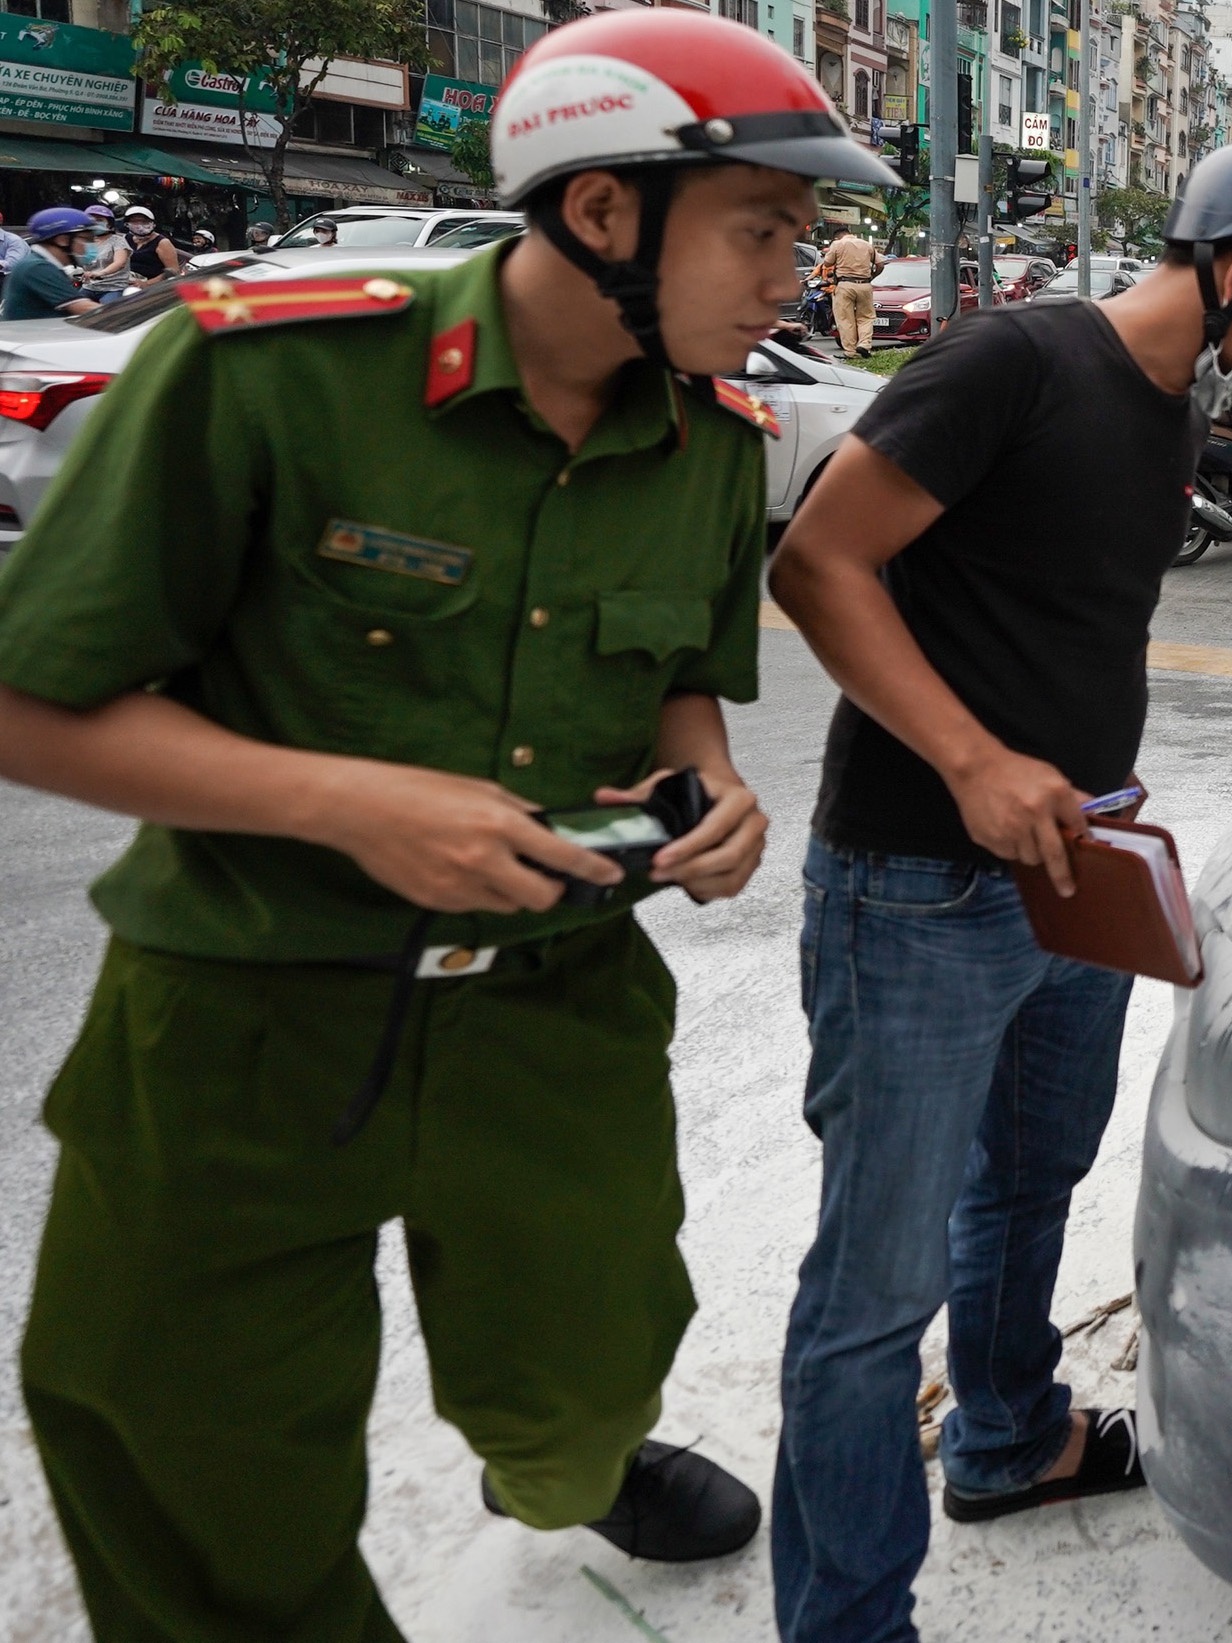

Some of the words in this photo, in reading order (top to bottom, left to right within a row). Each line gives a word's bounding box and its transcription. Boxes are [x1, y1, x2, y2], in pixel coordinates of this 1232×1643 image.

[14, 68, 31, 80] XE
[33, 70, 84, 87] CHUYÊN
[85, 79, 128, 94] NGHIỆP
[443, 87, 485, 113] HOA
[214, 113, 236, 124] HOA
